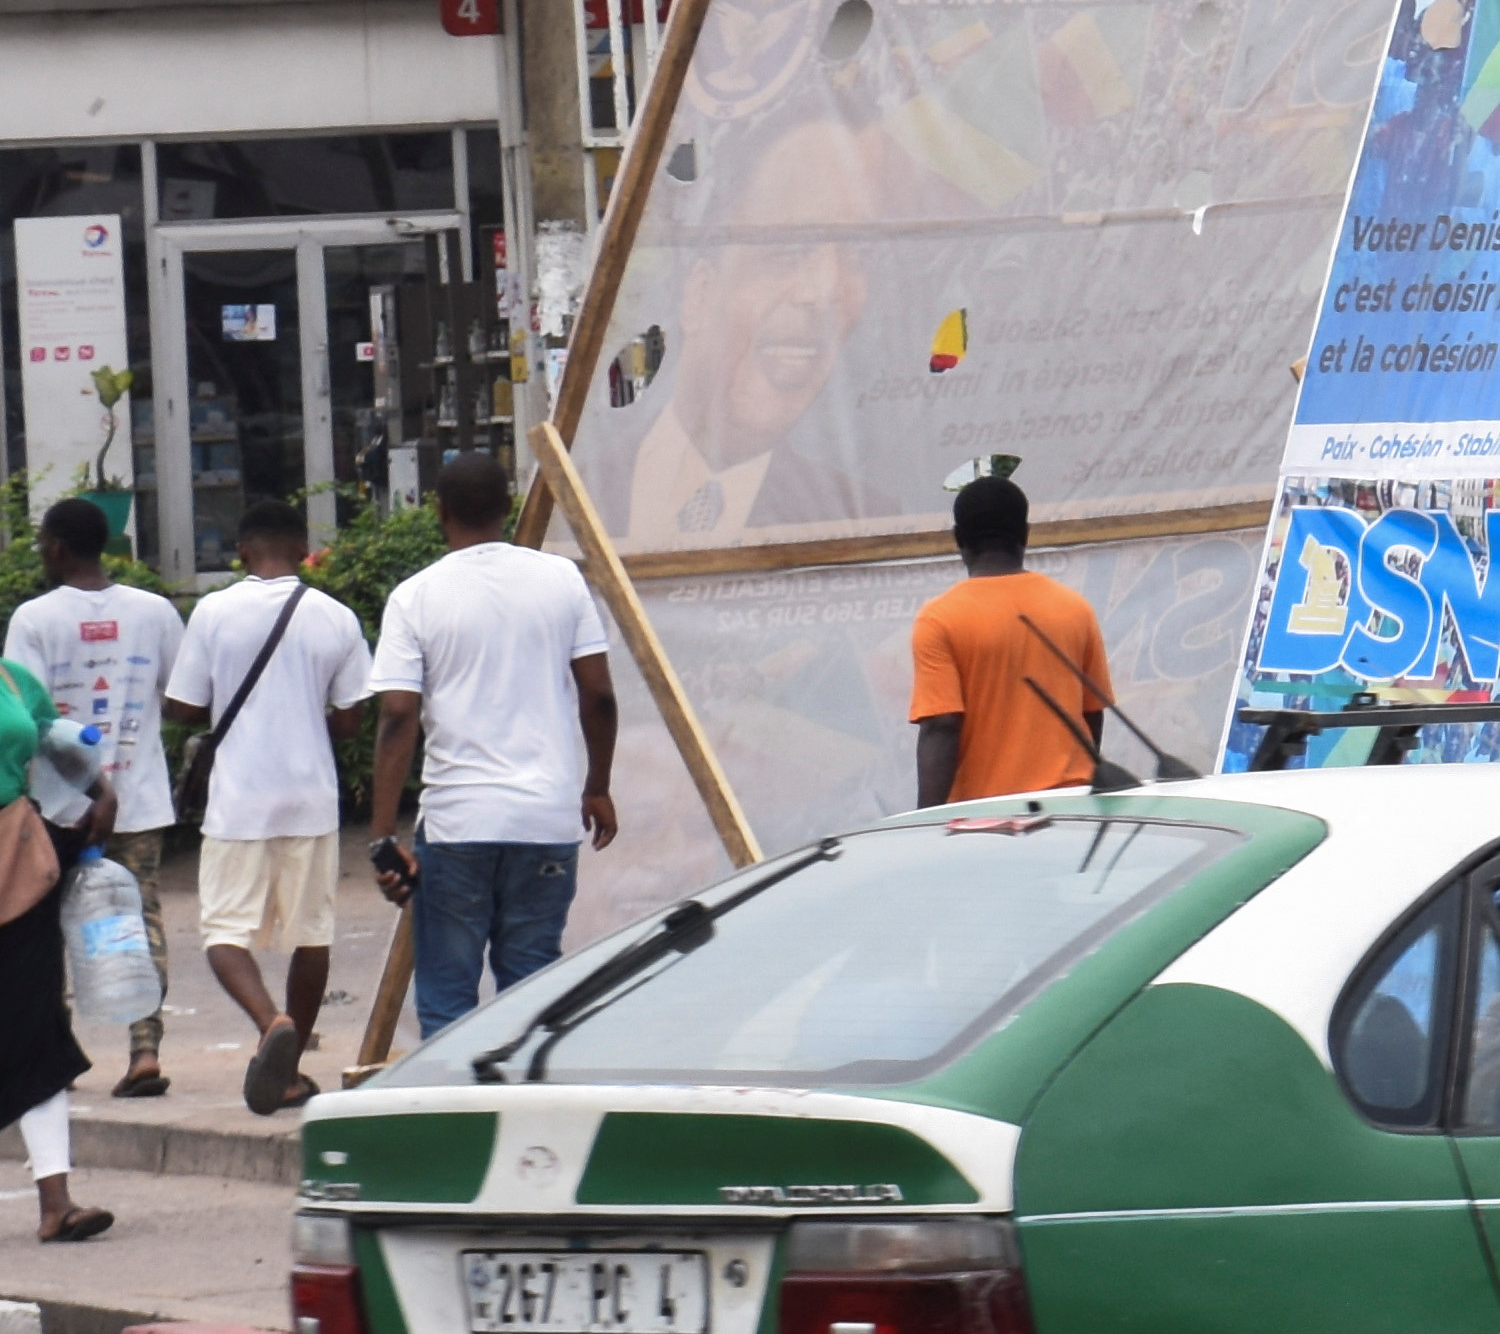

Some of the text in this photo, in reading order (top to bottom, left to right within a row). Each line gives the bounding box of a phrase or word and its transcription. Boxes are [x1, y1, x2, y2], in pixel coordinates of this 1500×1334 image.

[1350, 215, 1426, 252] Voter
[1333, 271, 1398, 313] c'est
[1400, 271, 1498, 312] choisir
[1318, 337, 1349, 374] et
[1351, 334, 1377, 373] la
[1380, 332, 1499, 373] cohésion
[1321, 435, 1356, 461] Paix
[1368, 431, 1443, 460] Cohésion
